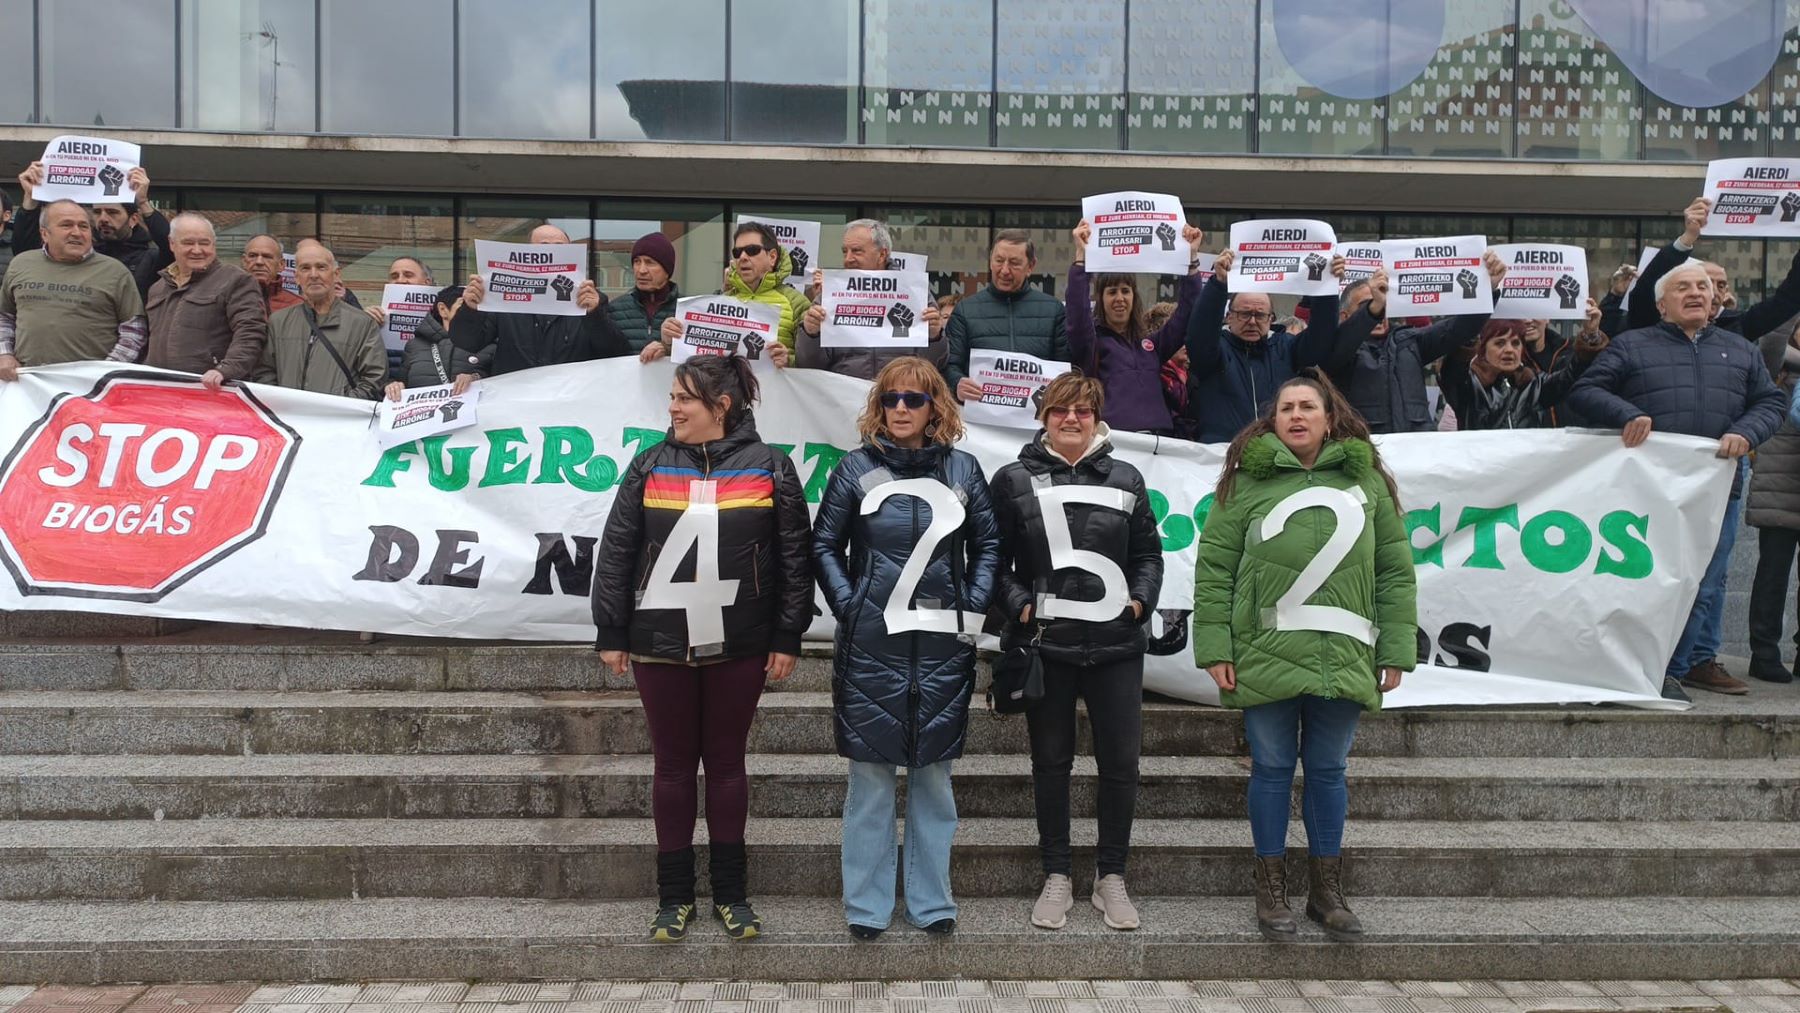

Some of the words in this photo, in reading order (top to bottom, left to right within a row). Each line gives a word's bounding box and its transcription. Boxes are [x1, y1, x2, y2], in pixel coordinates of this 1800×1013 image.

[58, 141, 107, 155] AIERDI
[1744, 167, 1789, 179] AIERDI
[1722, 195, 1776, 204] ARROITZEKO
[1115, 200, 1155, 212] AIERDI
[1716, 206, 1762, 214] BIOGASARI
[1101, 228, 1151, 236] ARROITZEKO
[1262, 229, 1307, 241] AIERDI
[1101, 237, 1142, 246] BIOGASARI
[509, 252, 553, 264] AIERDI
[1415, 246, 1457, 258] AIERDI
[1514, 251, 1563, 264] AIERDI
[1244, 257, 1297, 265] ARROITZEKO
[494, 275, 545, 286] ARROITZEKO
[847, 277, 897, 292] AIERDI
[1401, 275, 1450, 283] ARROITZEKO
[492, 285, 535, 293] BIOGASARI
[1400, 285, 1442, 293] BIOGASARI
[405, 292, 437, 303] AIERD
[707, 303, 749, 318] AIERDI
[392, 316, 422, 324] ARROITZ
[836, 315, 878, 326] ARRÓNIZ
[689, 327, 738, 340] ARROITZEKO
[686, 338, 727, 349] BIOGASARI
[994, 358, 1042, 375] AIERDI
[984, 384, 1002, 392] STOP
[981, 395, 1023, 406] ARRÓNIZ
[38, 422, 260, 490] STOP
[42, 496, 196, 536] BIOGÁS
[352, 525, 485, 588] DE
[860, 478, 987, 637] 2
[1035, 483, 1137, 622] 5
[1261, 485, 1380, 648] 2
[638, 502, 742, 648] 4
